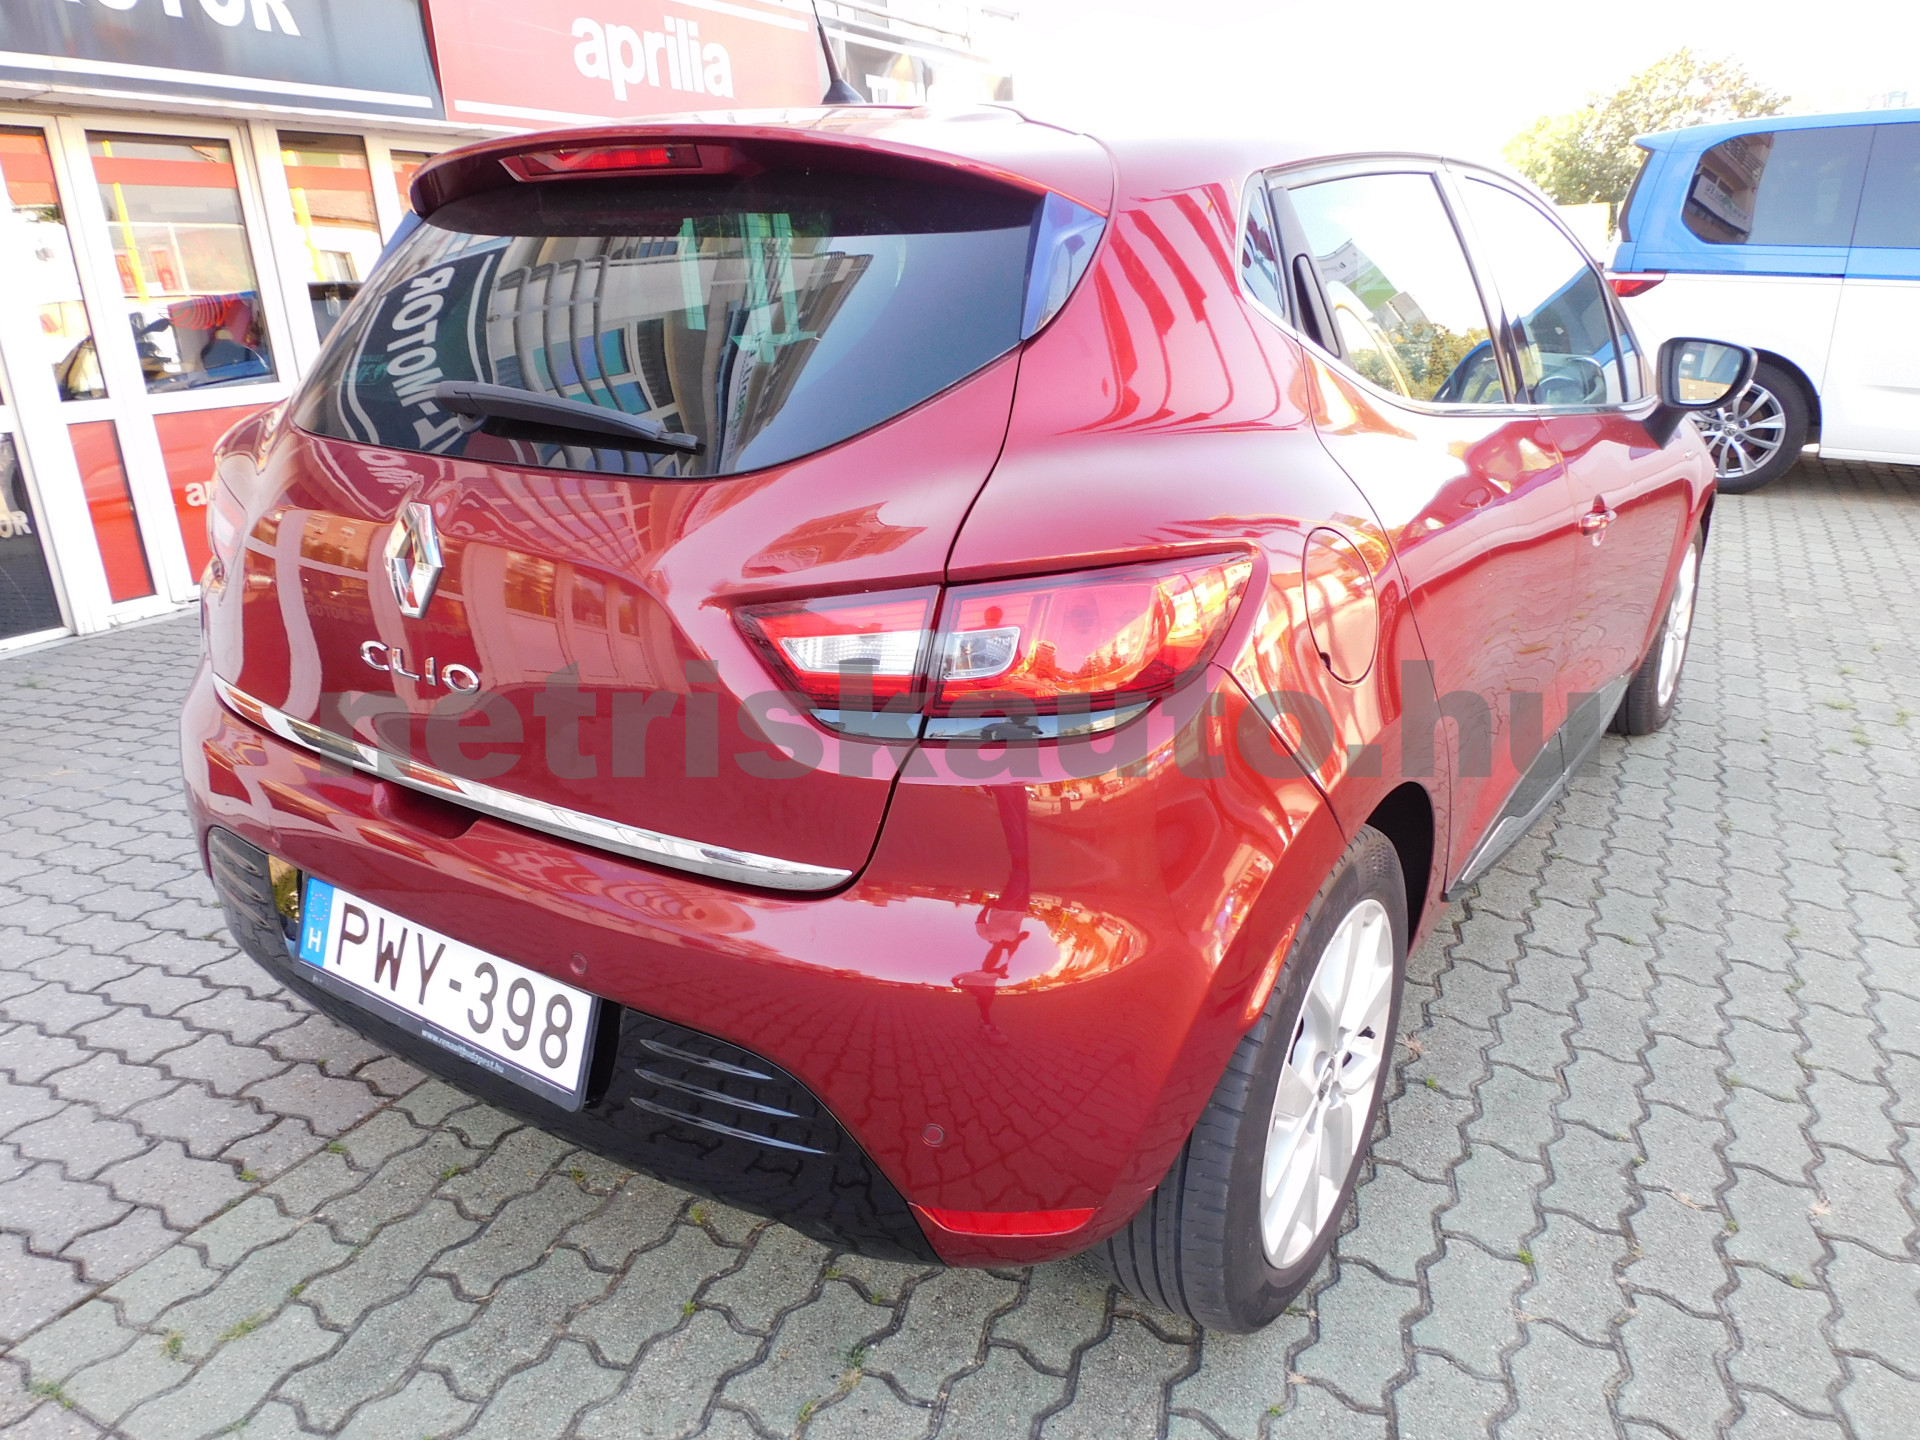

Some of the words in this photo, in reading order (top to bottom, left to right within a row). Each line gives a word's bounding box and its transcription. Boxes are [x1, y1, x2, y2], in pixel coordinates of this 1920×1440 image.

[571, 15, 734, 101] aprilia
[360, 640, 479, 695] CLIO
[307, 926, 322, 953] H
[336, 902, 573, 1069] PWY-398
